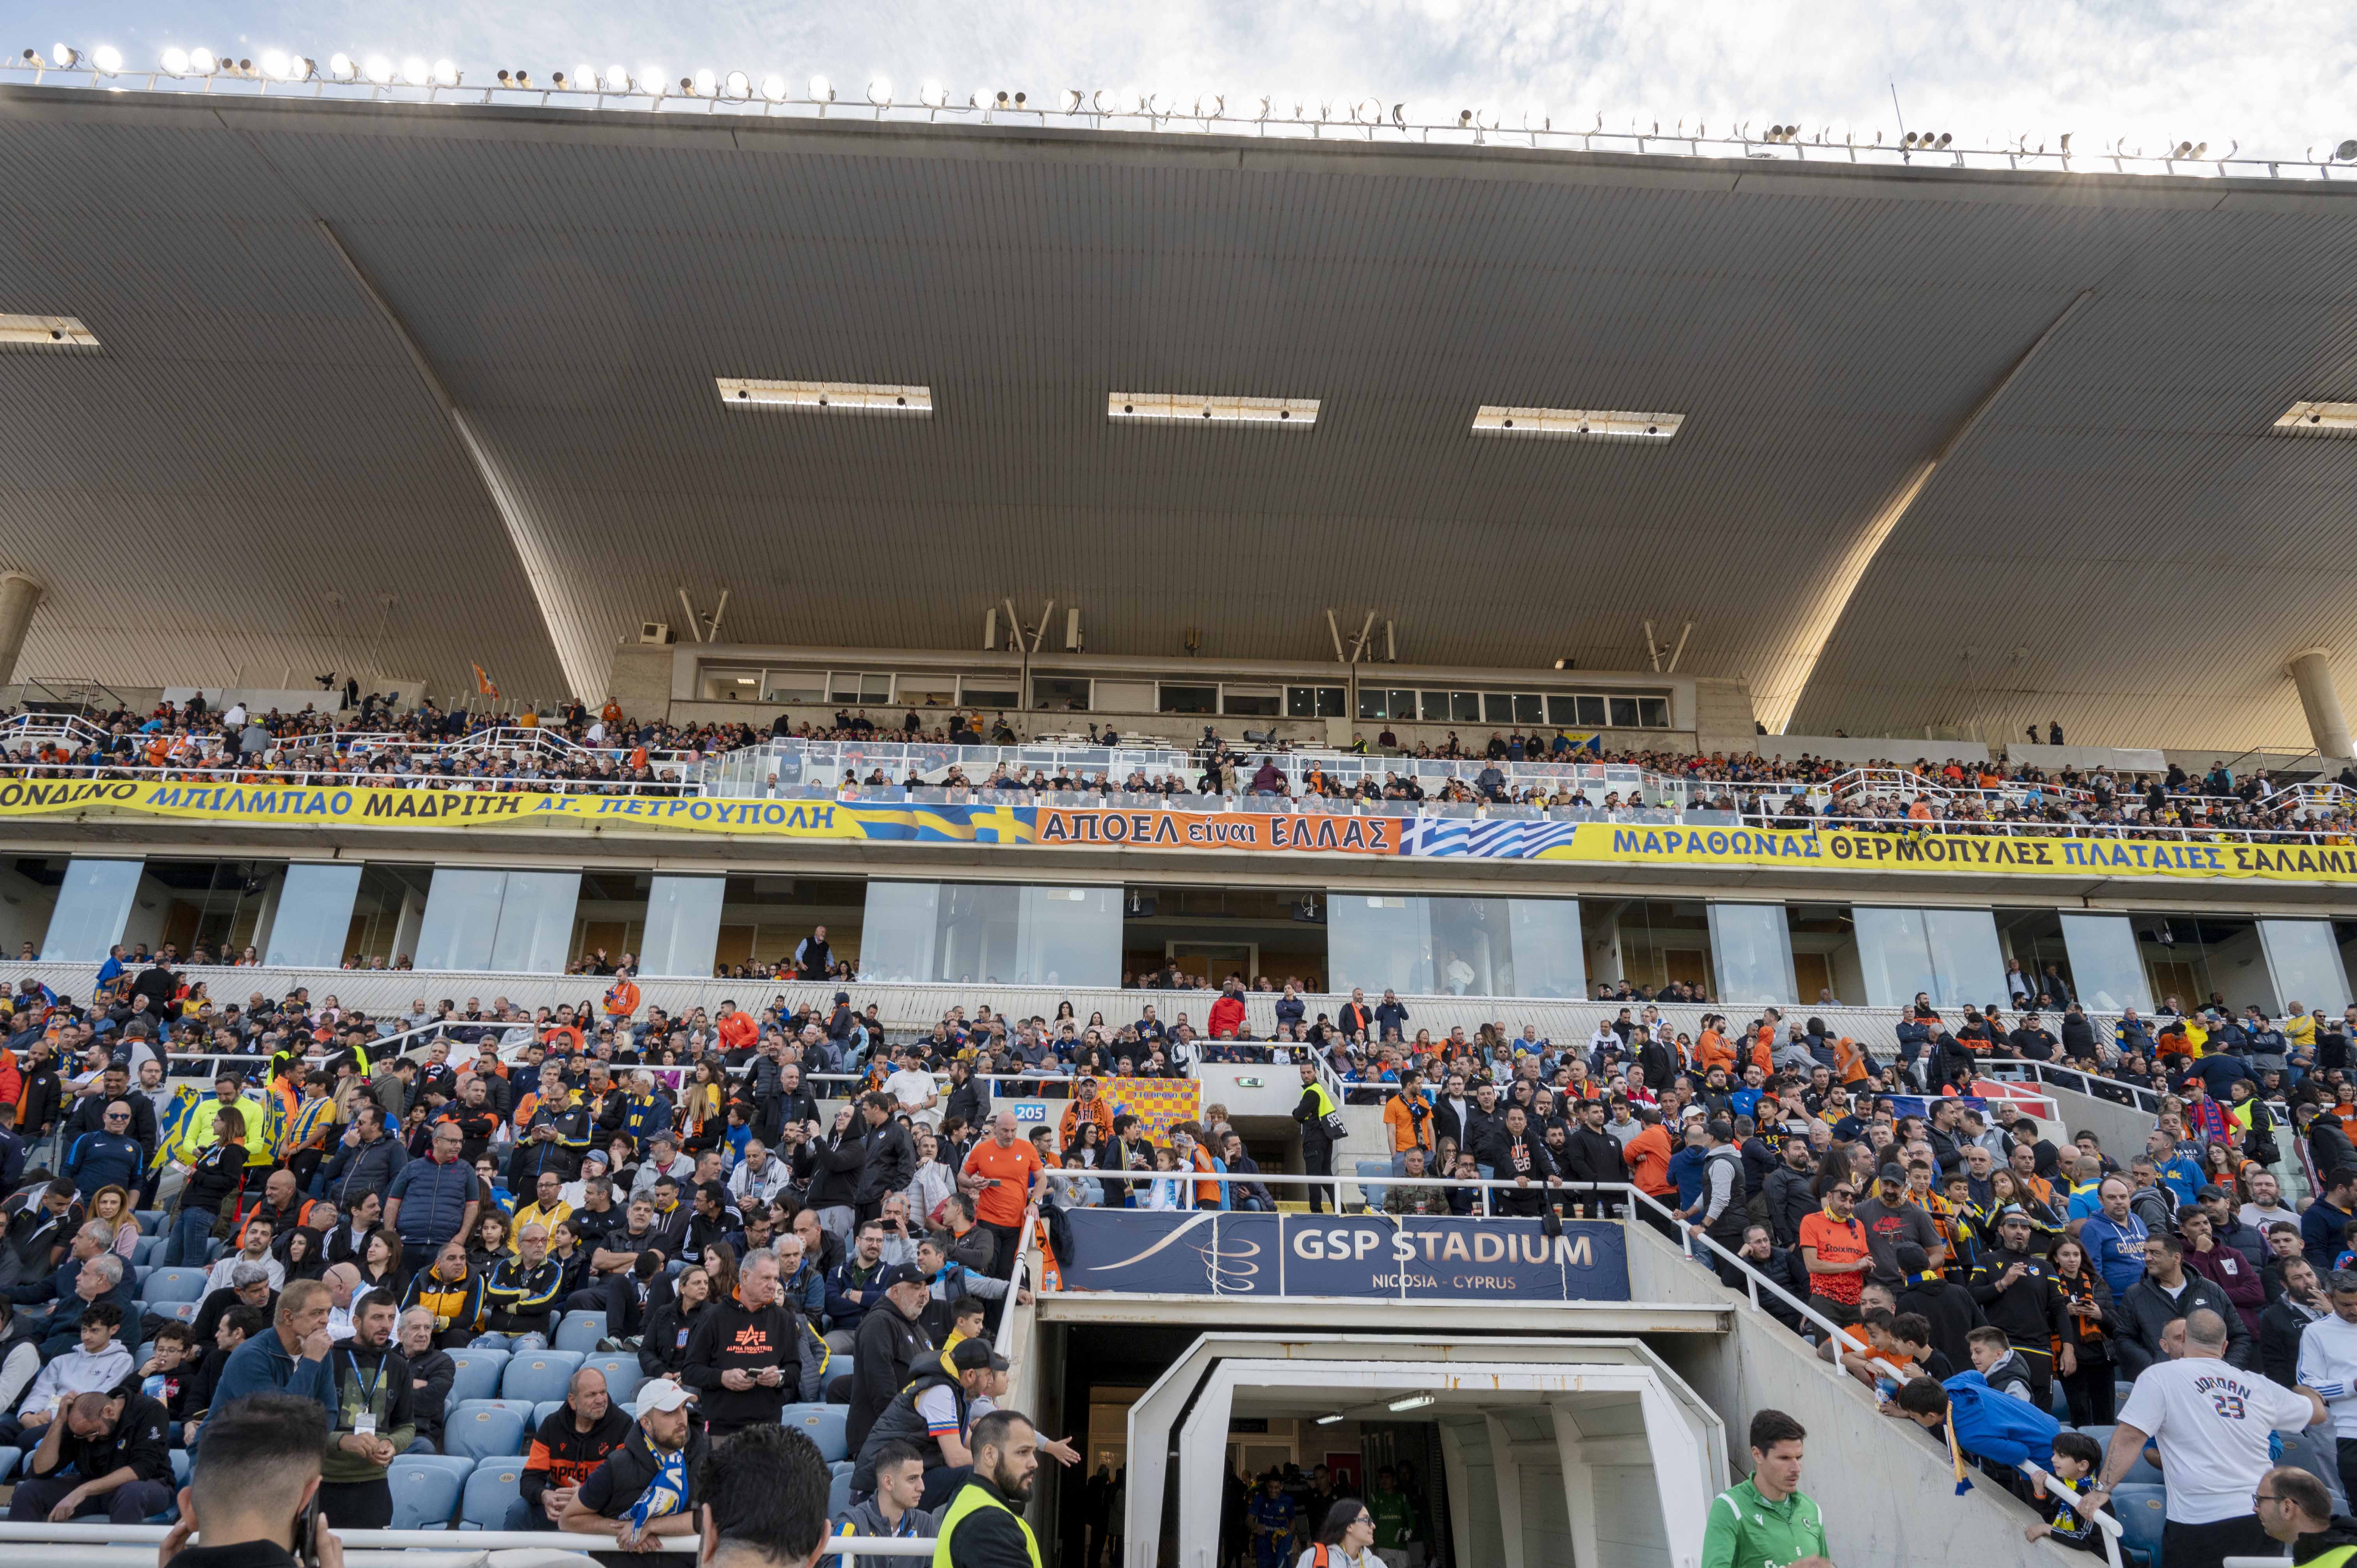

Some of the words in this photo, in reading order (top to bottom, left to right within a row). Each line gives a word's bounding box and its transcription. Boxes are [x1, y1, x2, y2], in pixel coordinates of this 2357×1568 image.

[146, 789, 353, 814] ΜΠΙΛΜΠΑΟ
[363, 793, 523, 818] ΜΑΔΡΙΤΗ
[597, 798, 836, 829] ΠΕΤΡΟΥΠΟΛΗ
[1042, 812, 1180, 844] ΑΠΟΕΛ
[1189, 816, 1256, 843] είναι
[1270, 816, 1388, 850] ΕΛΛΑΣ
[1613, 829, 1821, 857] ΜΑΡΑΘΩΝΑΣ
[1831, 835, 2054, 865] ΘΕΡΜΟΠΥΛΕΣ
[2061, 842, 2226, 869] ΠΛΑΤΑΙΕΣ
[1017, 1107, 1043, 1119] 205
[1293, 1229, 1380, 1261] GSP
[1392, 1230, 1593, 1265] STADIUM
[1372, 1274, 1438, 1289] NICOSIA
[1453, 1275, 1516, 1290] CYPRUS
[2194, 1377, 2251, 1400] JORDAN
[2212, 1395, 2246, 1420] 23
